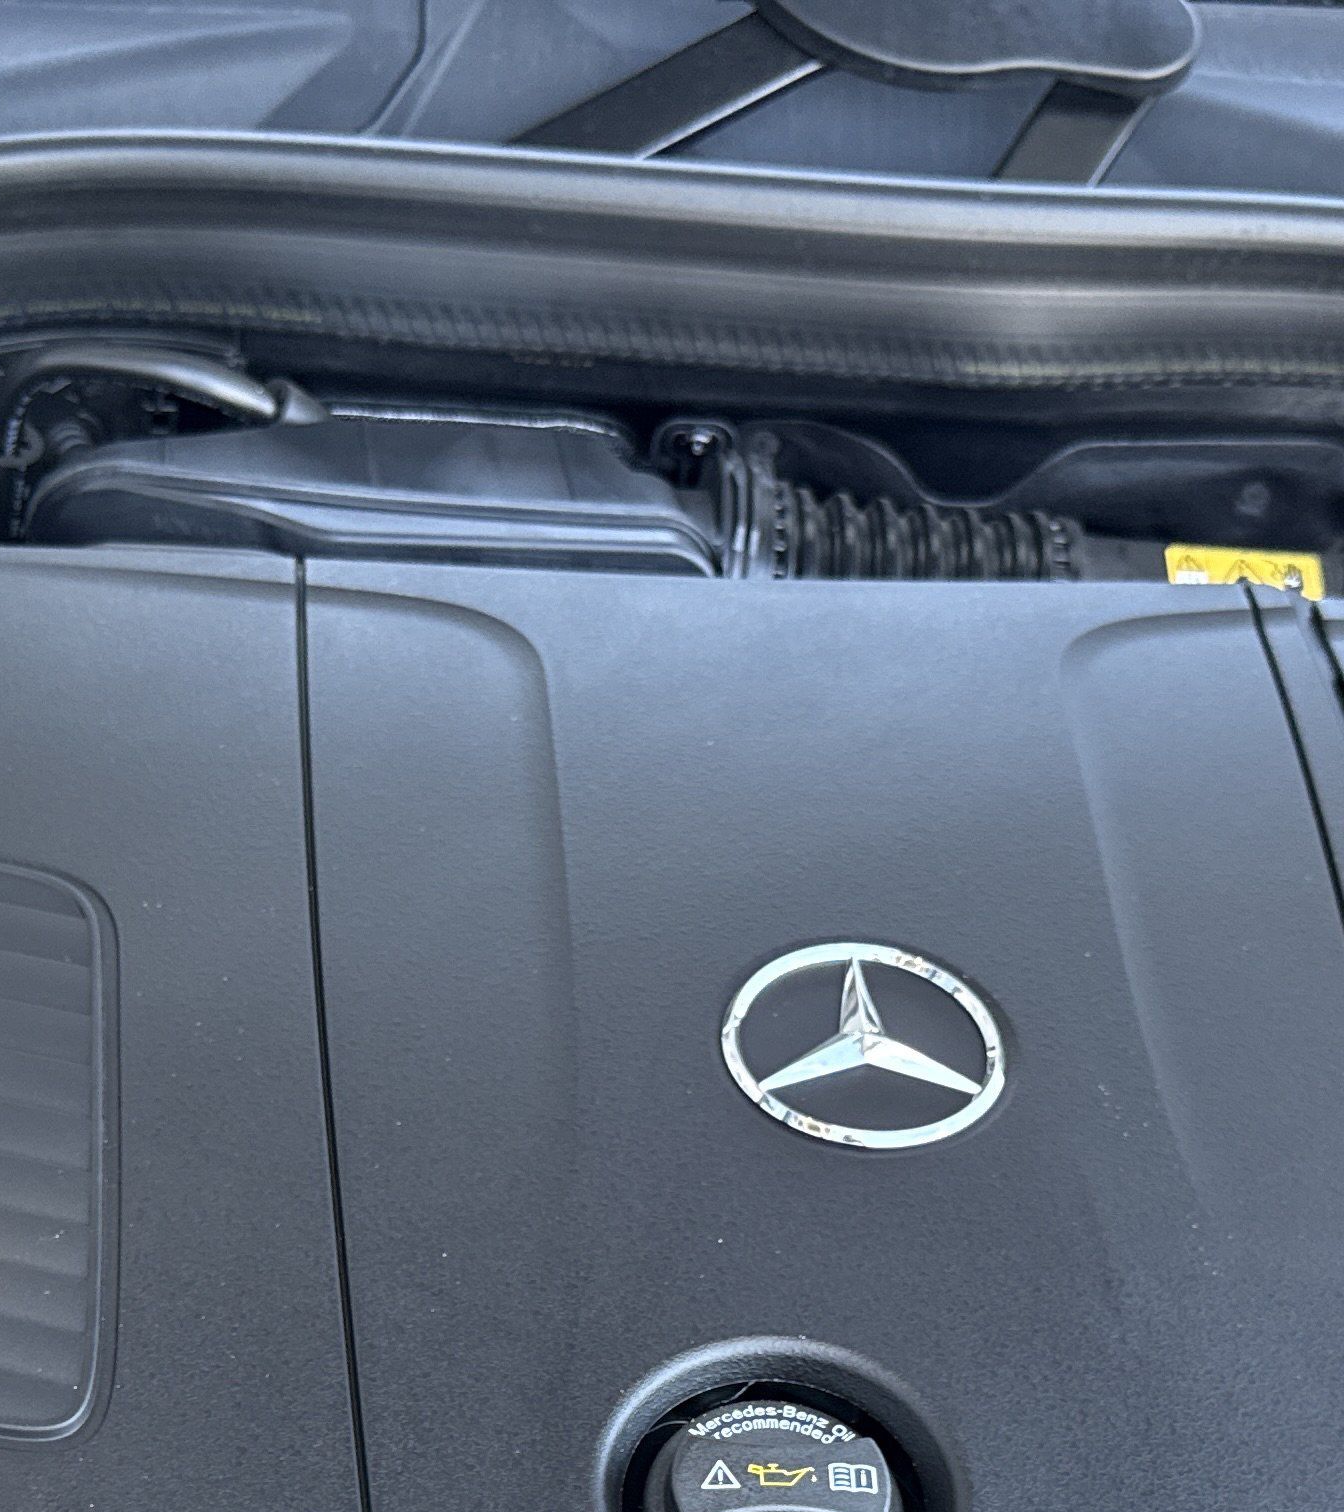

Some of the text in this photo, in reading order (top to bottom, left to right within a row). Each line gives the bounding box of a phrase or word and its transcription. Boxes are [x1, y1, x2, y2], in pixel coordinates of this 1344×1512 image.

[688, 1405, 856, 1442] Mercedes-Benz Oil
[712, 1418, 837, 1444] recommended
